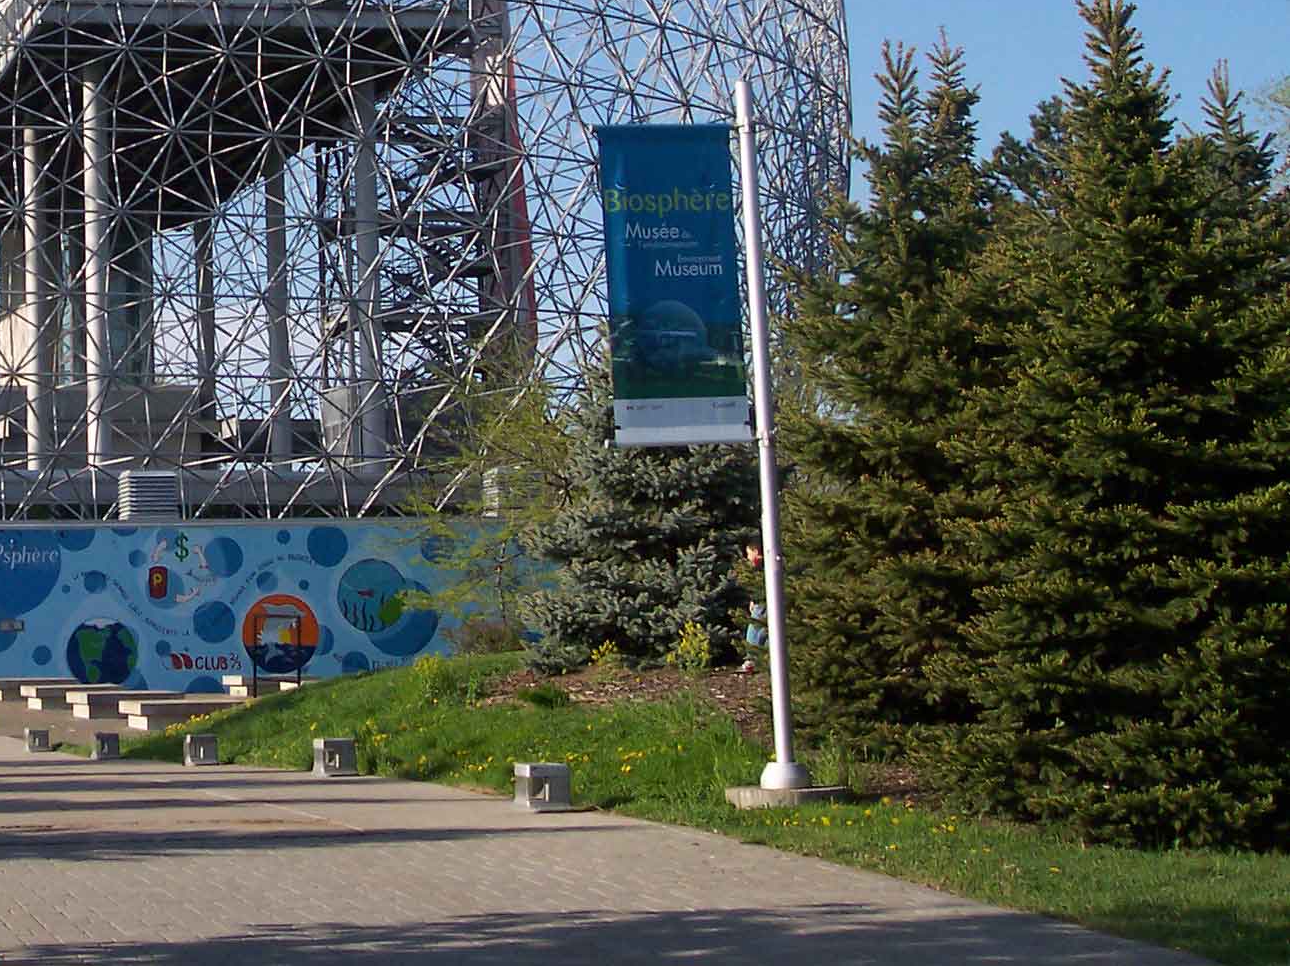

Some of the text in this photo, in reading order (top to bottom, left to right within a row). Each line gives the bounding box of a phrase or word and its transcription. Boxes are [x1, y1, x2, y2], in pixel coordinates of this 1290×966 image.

[605, 186, 730, 218] Biosphère
[625, 220, 679, 240] Musée
[654, 260, 723, 277] Museum
[195, 656, 228, 671] CLUB
